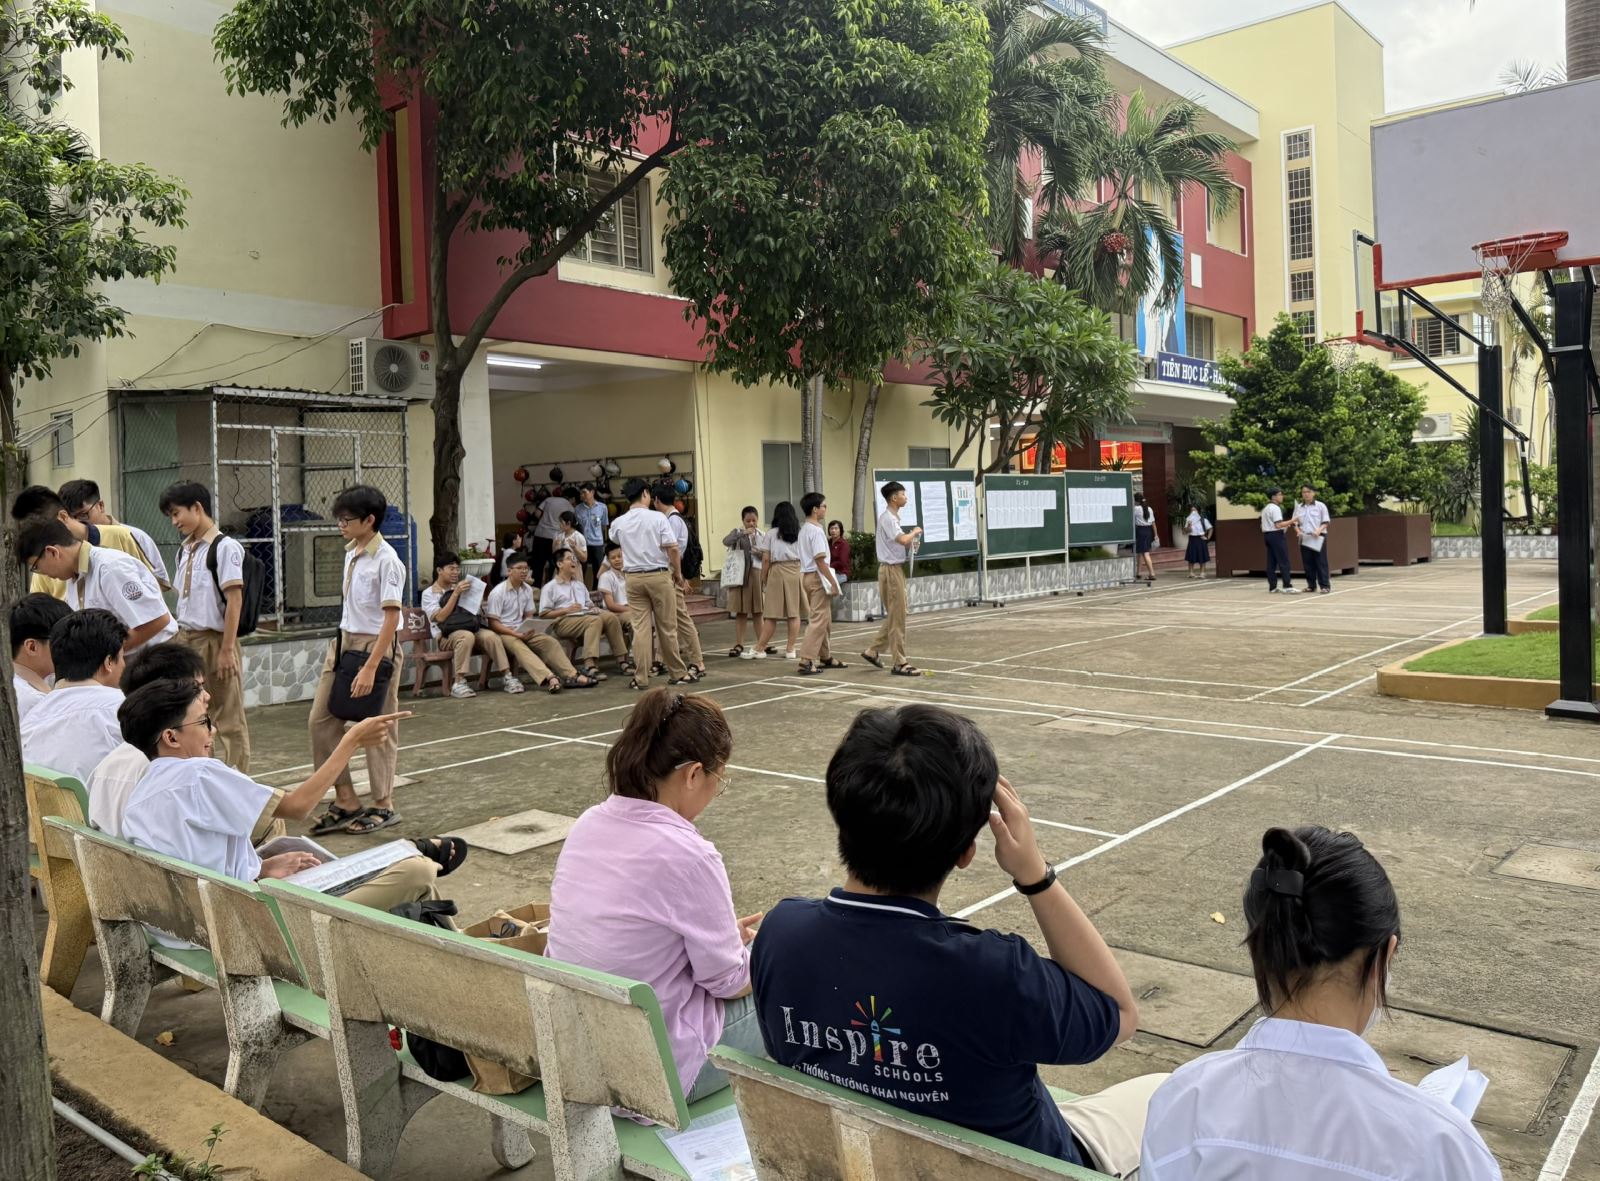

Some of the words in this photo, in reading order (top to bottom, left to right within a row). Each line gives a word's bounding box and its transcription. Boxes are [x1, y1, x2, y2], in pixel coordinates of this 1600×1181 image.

[1161, 357, 1180, 378] TIÊN
[1182, 363, 1198, 384] HỌC
[779, 1006, 941, 1069] Inspire
[802, 1062, 829, 1081] THỐNG
[830, 1073, 869, 1093] TRƯỜNG
[871, 1085, 897, 1099] KHAI
[899, 1090, 949, 1102] NGUYÊN
[874, 1065, 944, 1082] SCHOOLS
